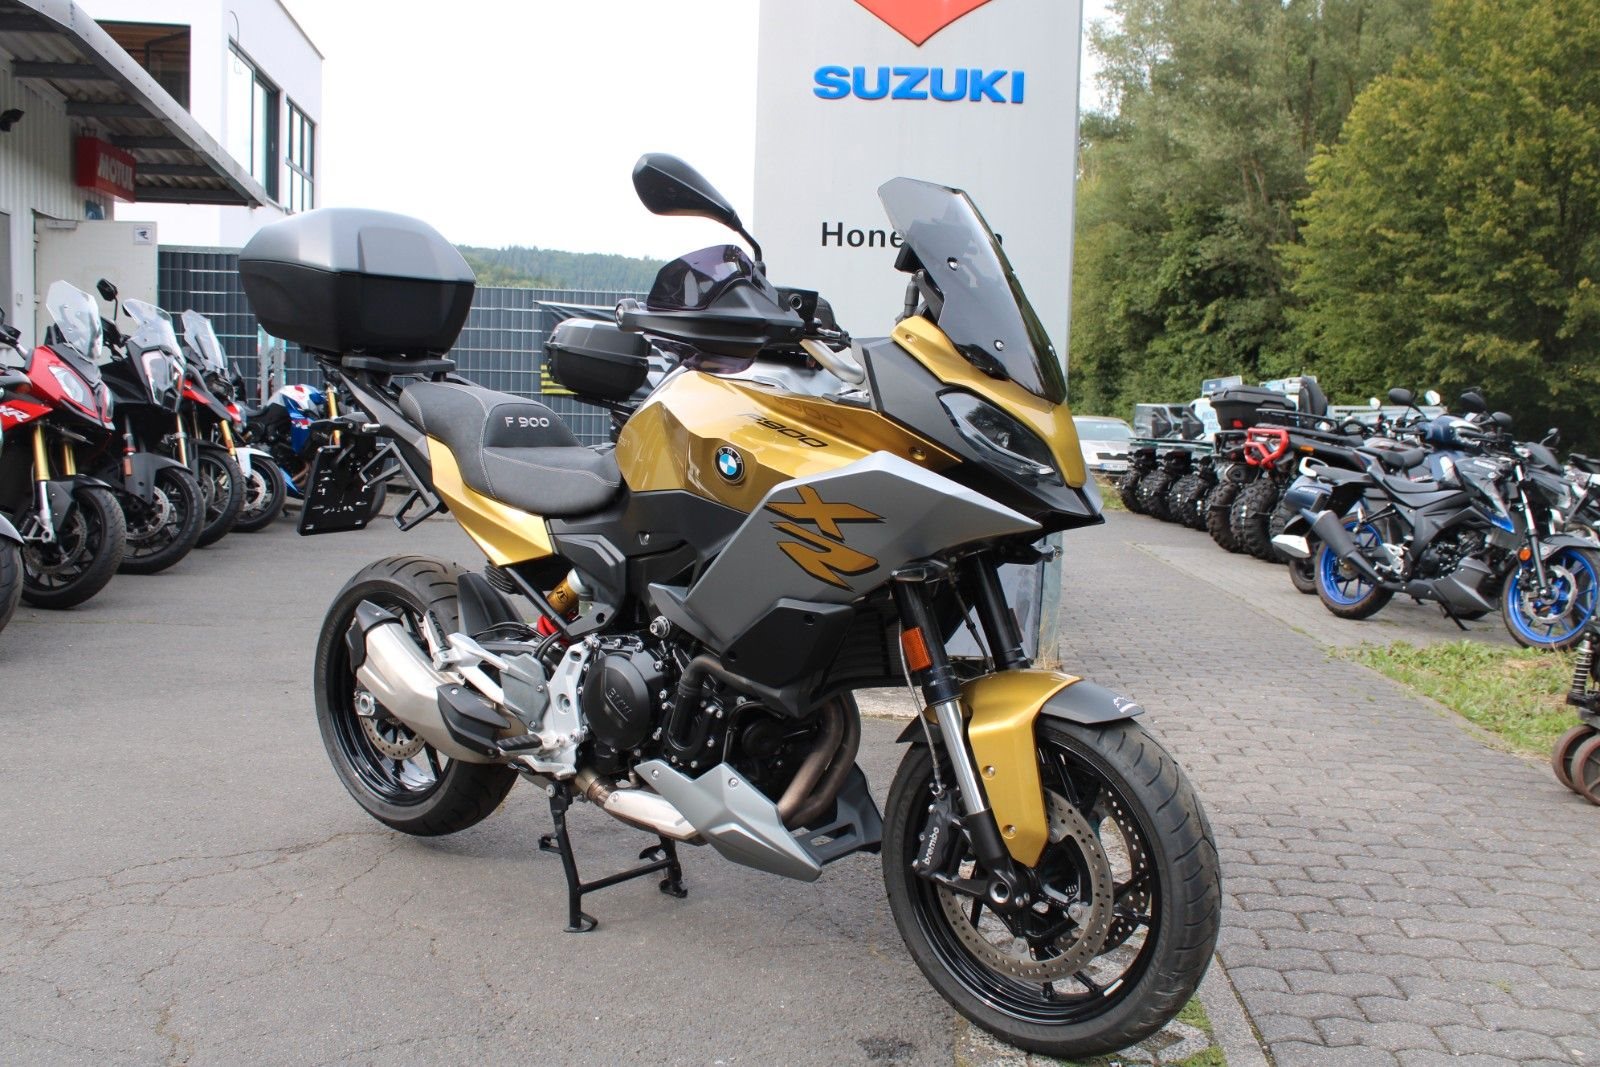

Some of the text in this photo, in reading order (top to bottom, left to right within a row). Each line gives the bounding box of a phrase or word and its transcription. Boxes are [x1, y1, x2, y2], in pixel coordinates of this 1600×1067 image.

[813, 65, 1025, 104] SUZUKI
[97, 152, 134, 192] MOTUL
[504, 416, 550, 428] F 900
[717, 447, 743, 464] BMW
[763, 484, 887, 593] XR
[922, 826, 940, 866] brembo
